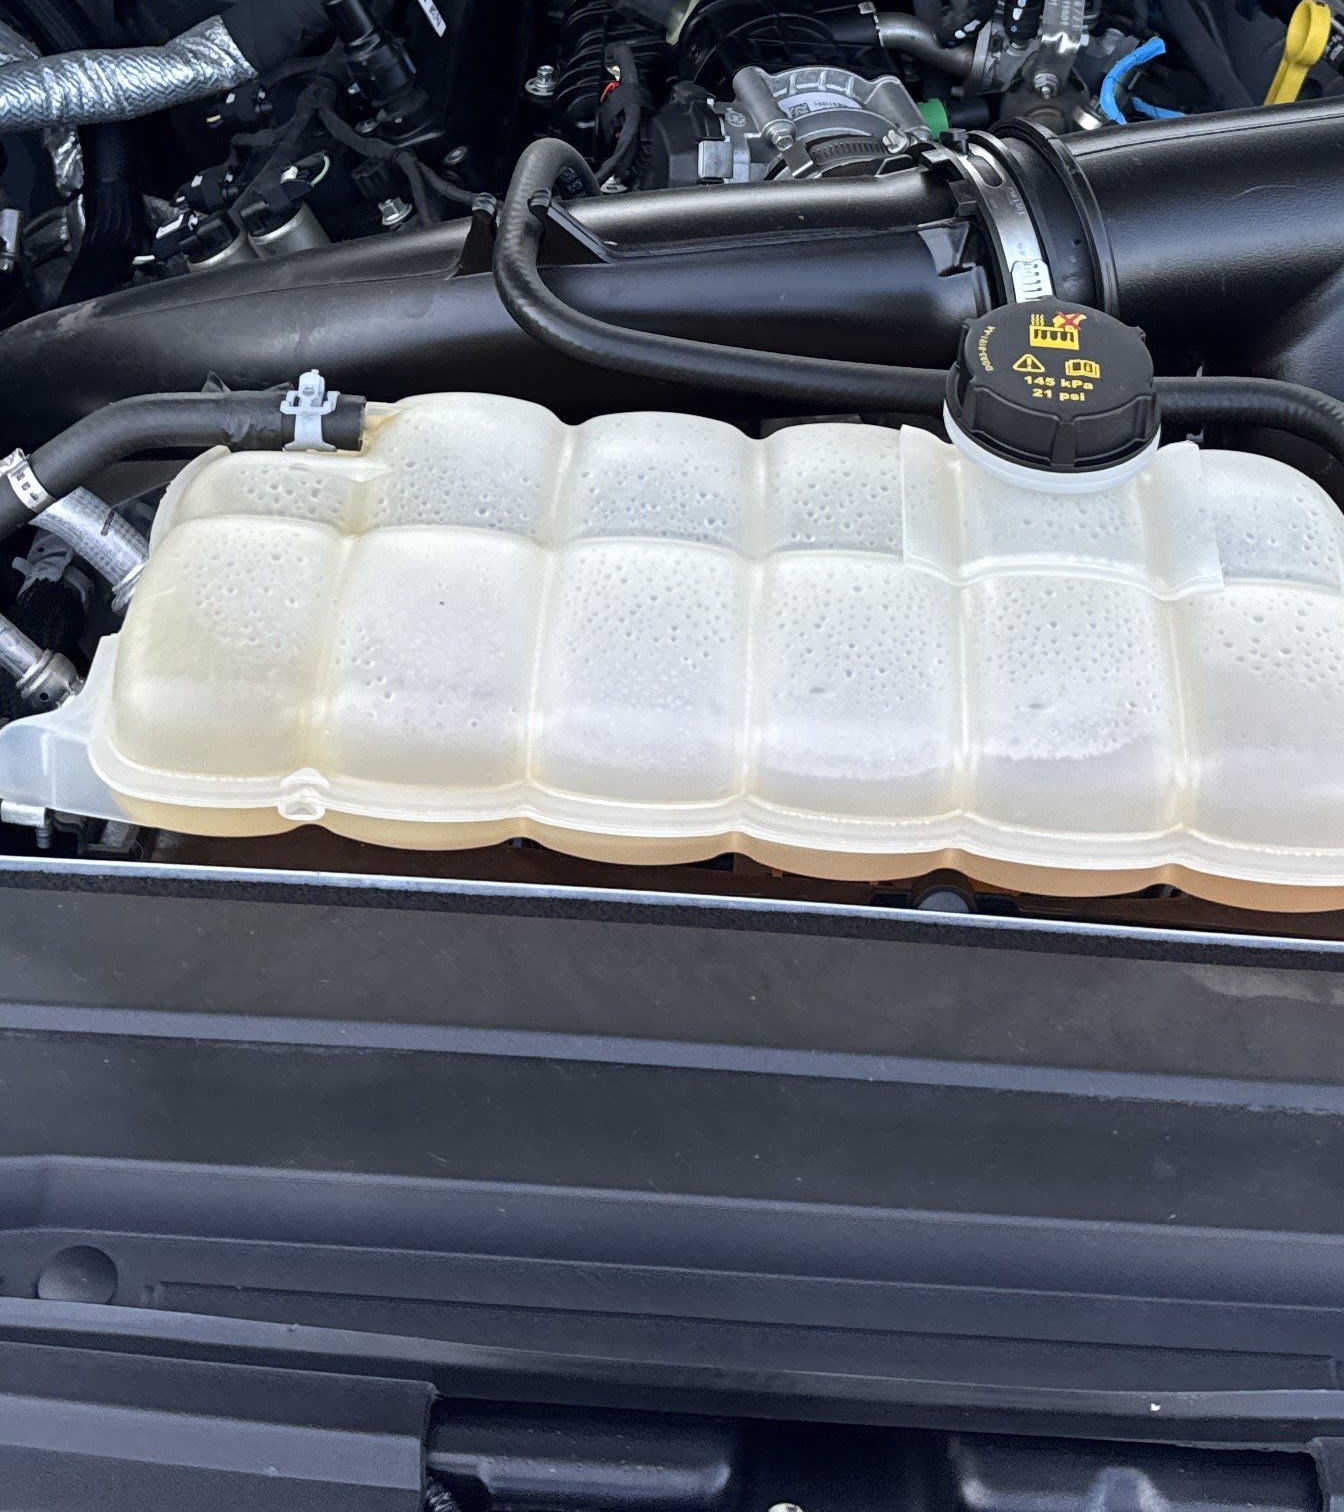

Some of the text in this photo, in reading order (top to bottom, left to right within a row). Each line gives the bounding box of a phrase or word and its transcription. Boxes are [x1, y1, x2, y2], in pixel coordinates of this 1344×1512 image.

[1024, 375, 1094, 390] 145 kPa
[1032, 388, 1086, 402] 21 psi
